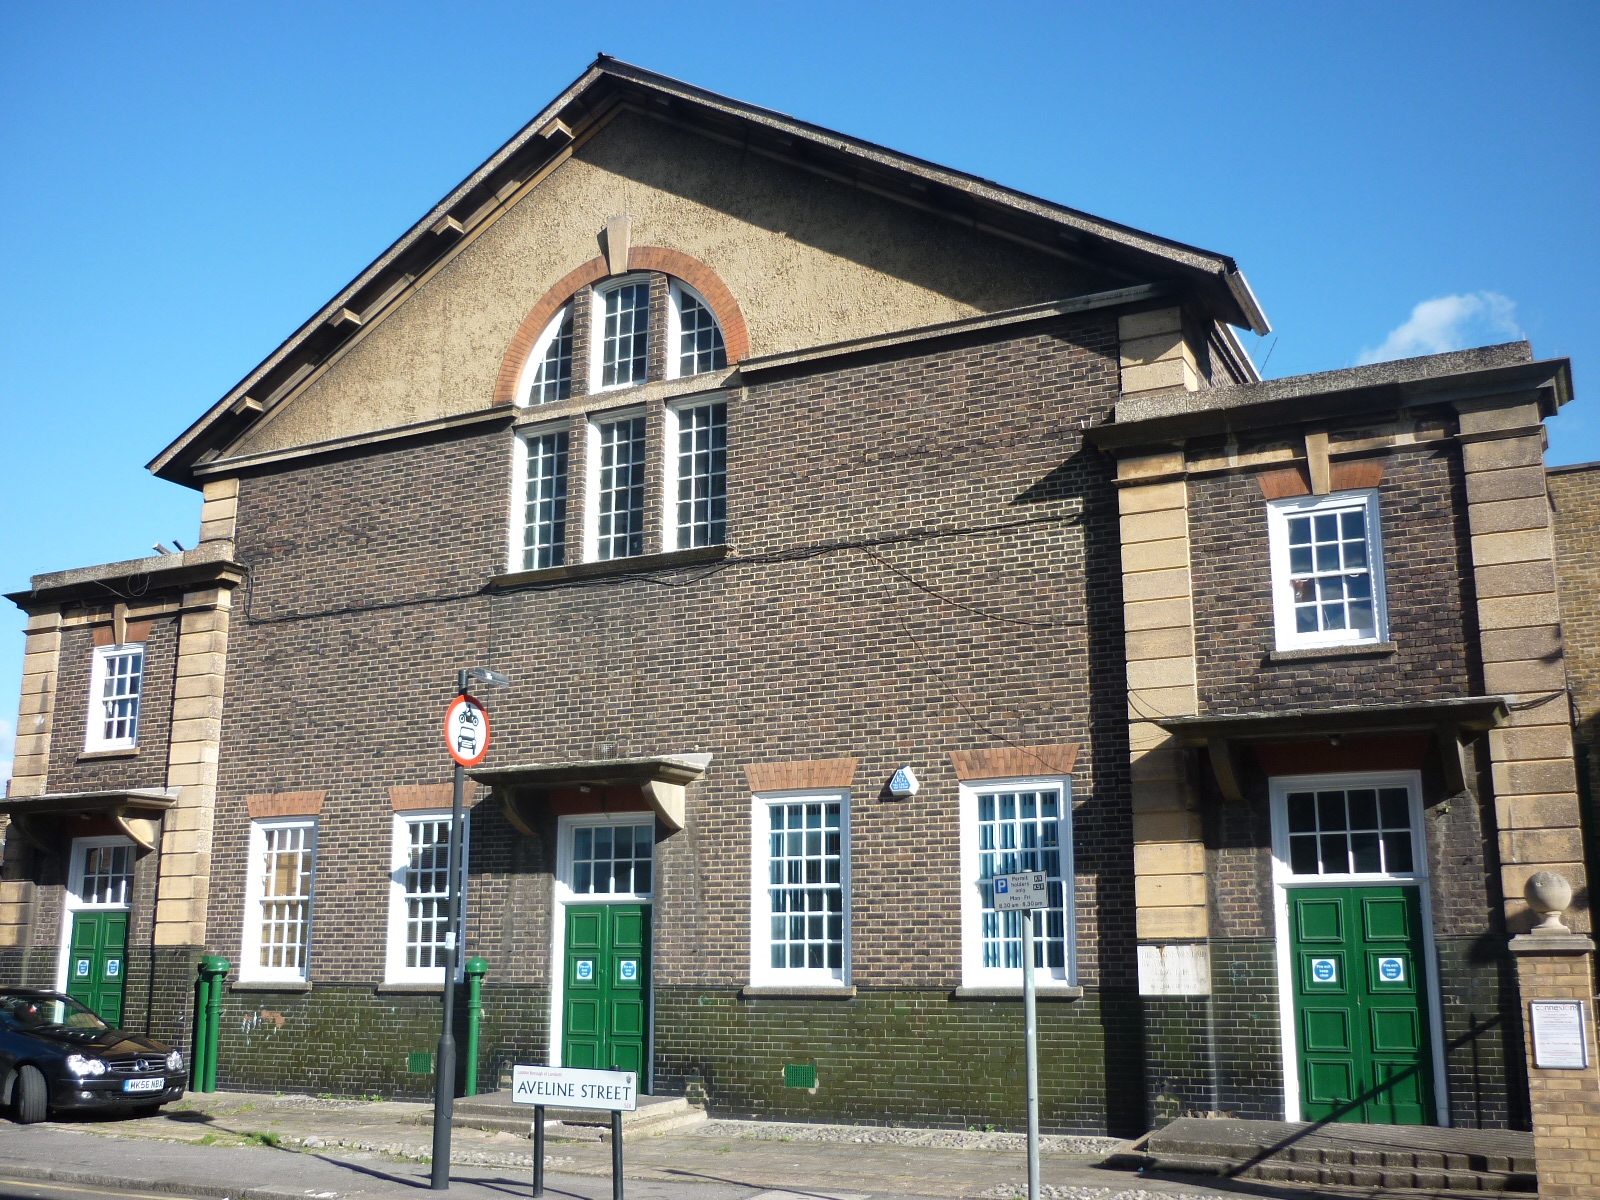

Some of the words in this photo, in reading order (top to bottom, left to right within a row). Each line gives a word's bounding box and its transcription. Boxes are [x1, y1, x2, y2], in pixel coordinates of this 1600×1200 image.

[997, 880, 1006, 893] P
[517, 1080, 575, 1097] AVELINE
[581, 1084, 632, 1101] STREET
